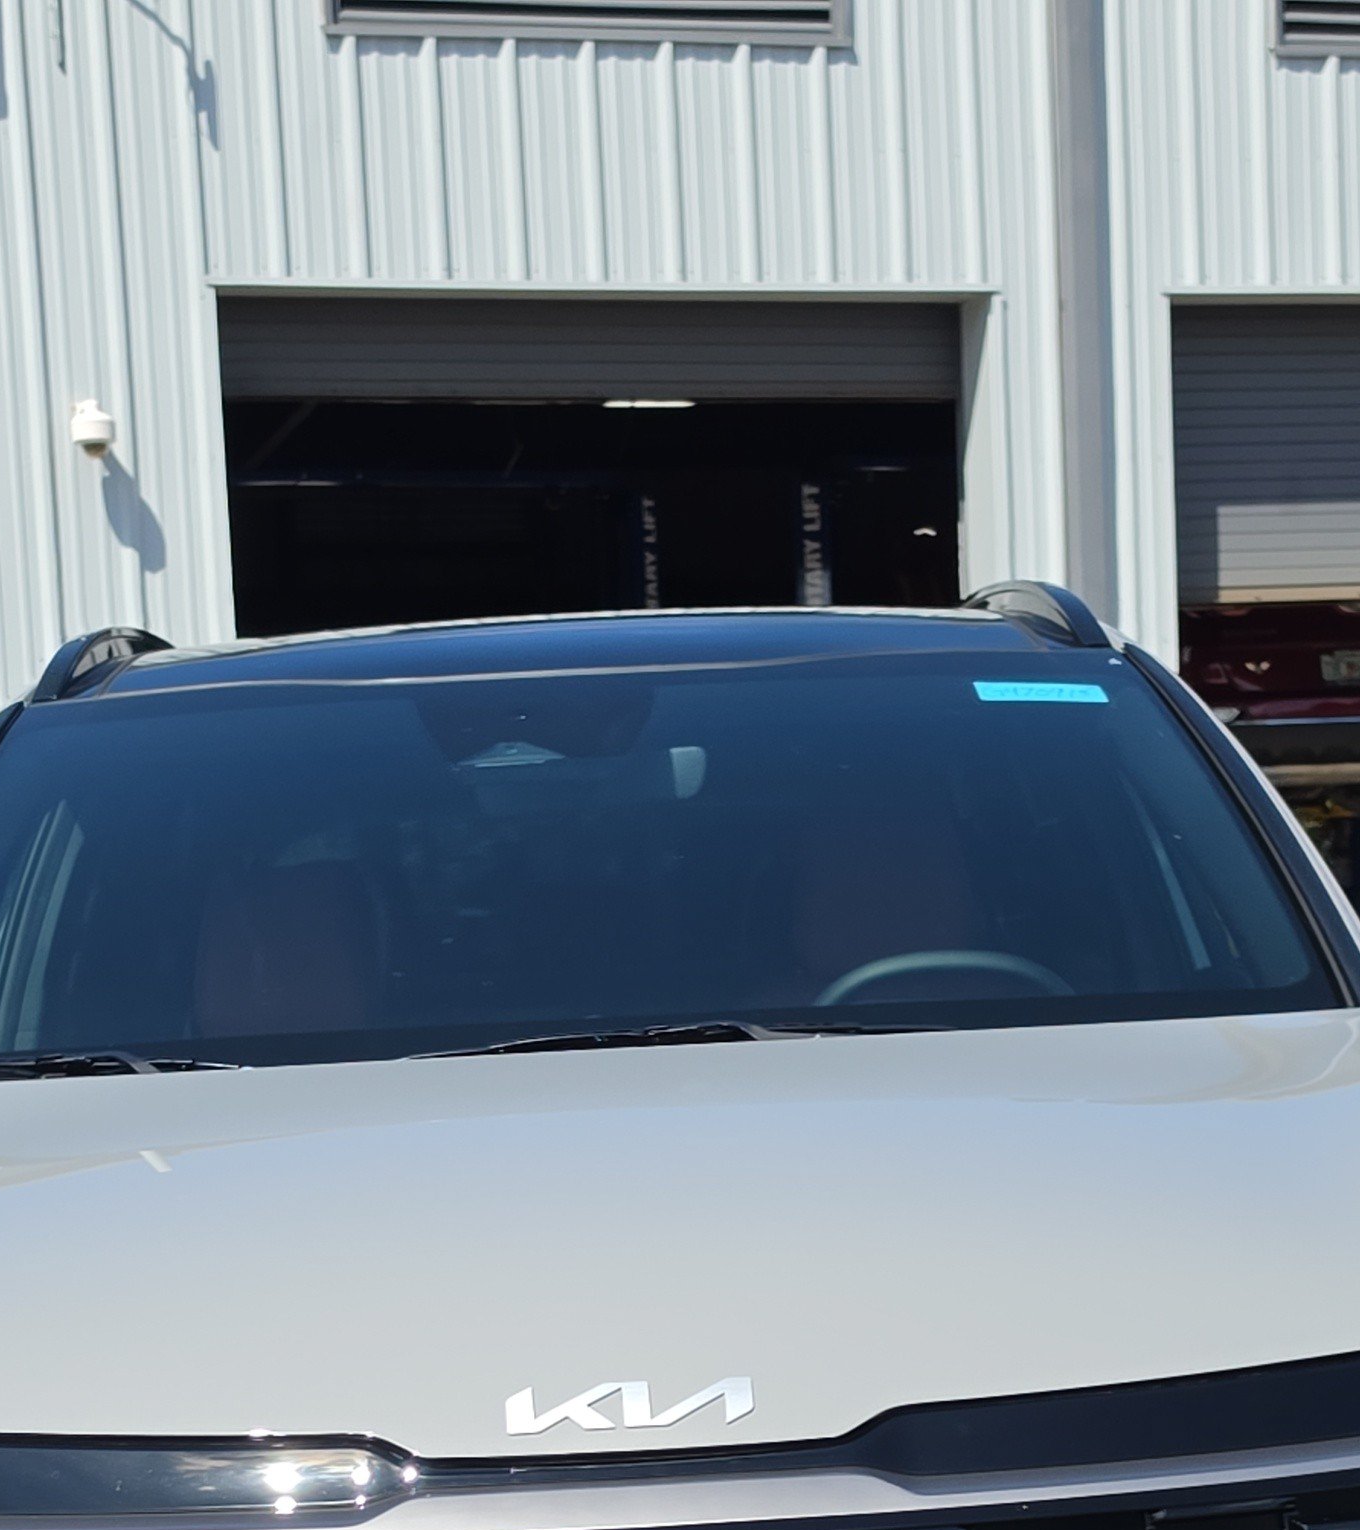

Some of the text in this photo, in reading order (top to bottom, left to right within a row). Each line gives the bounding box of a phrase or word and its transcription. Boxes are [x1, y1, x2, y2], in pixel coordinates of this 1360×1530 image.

[640, 497, 657, 544] LIFT
[799, 483, 821, 532] LIFT
[505, 1376, 756, 1436] KIA
